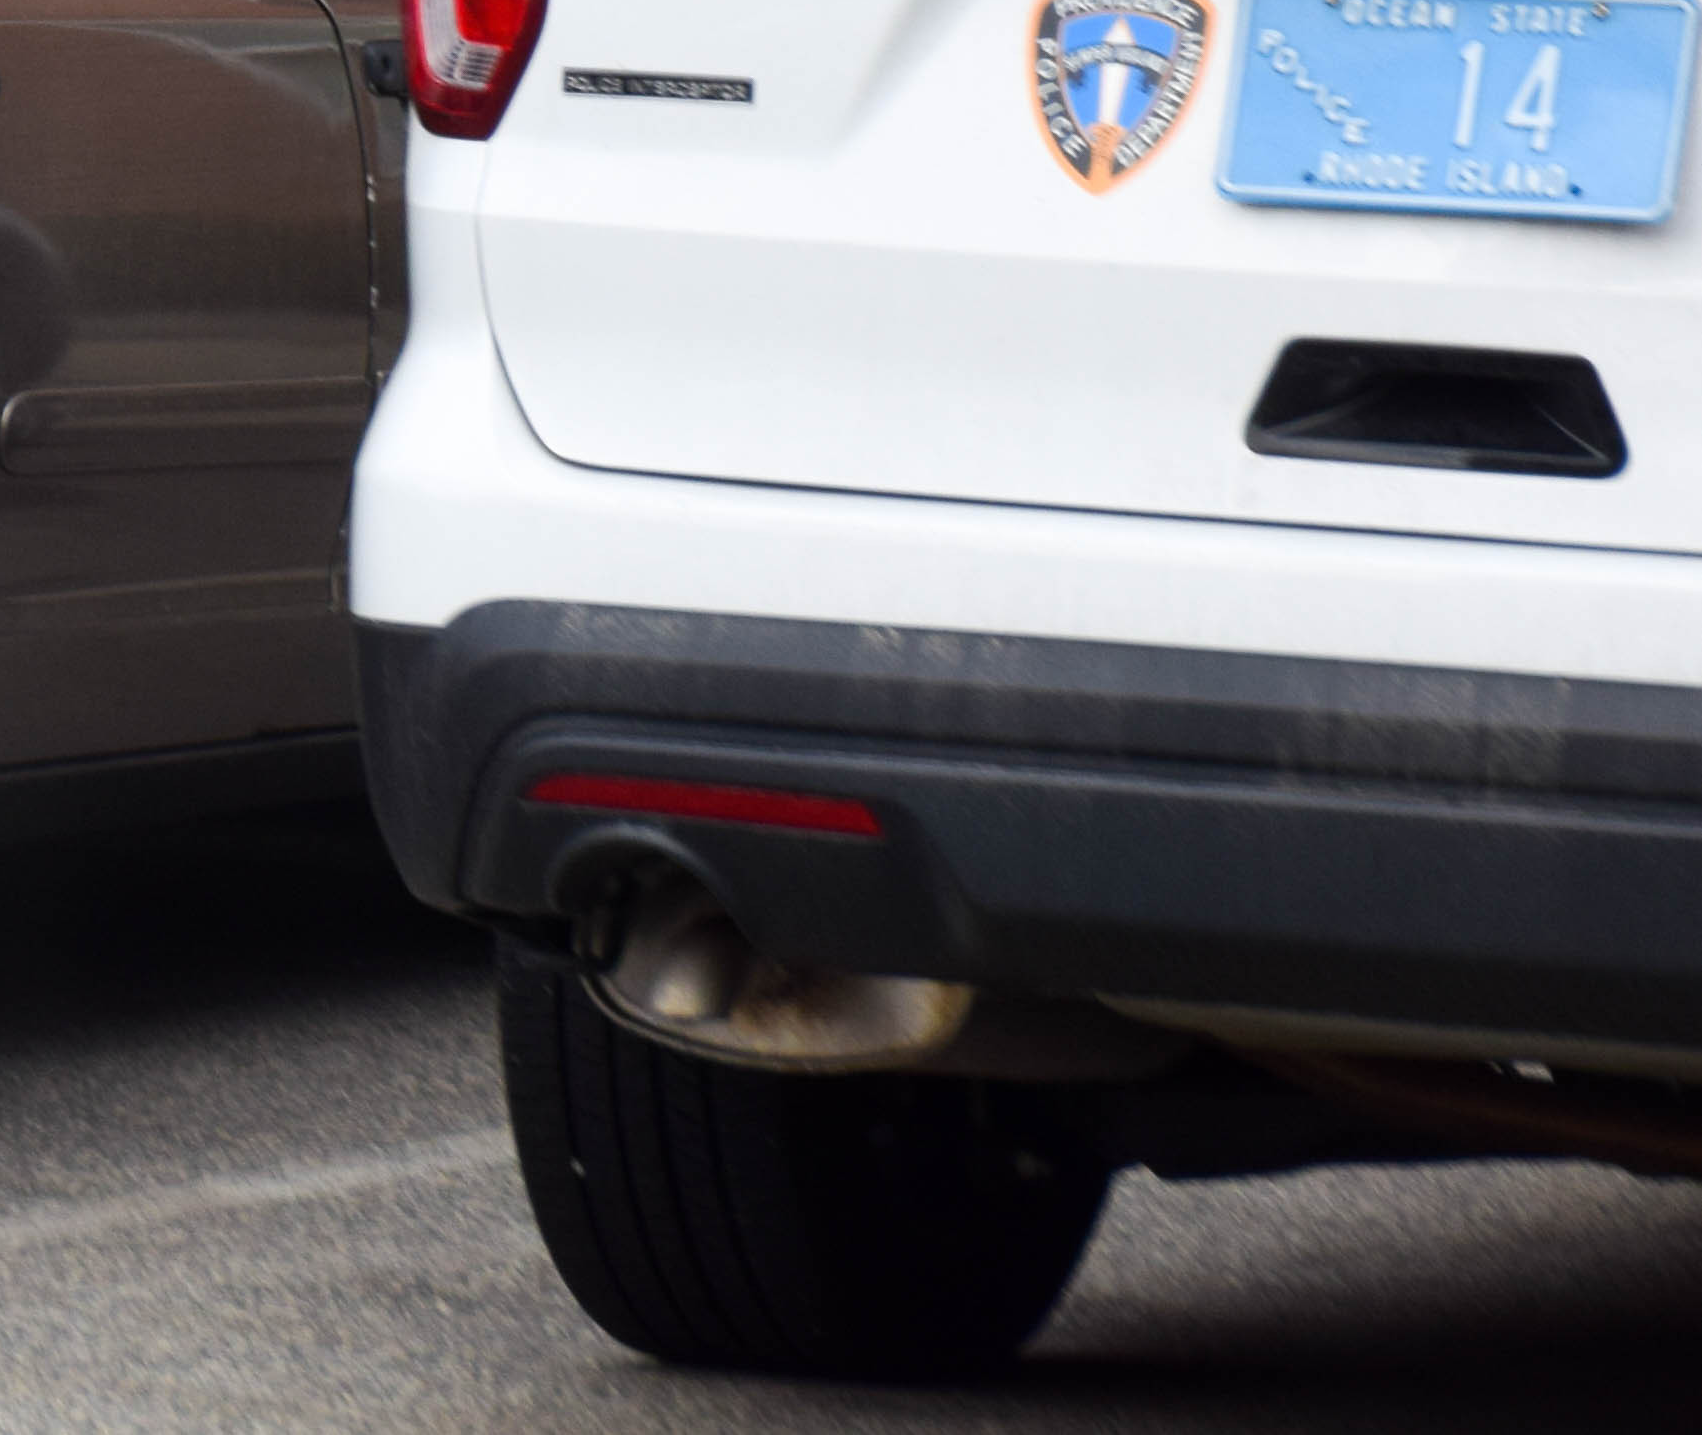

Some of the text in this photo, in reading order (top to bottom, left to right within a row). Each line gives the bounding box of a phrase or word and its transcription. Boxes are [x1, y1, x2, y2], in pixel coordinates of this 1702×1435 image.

[1489, 2, 1590, 38] STATE
[1036, 37, 1091, 160] POLICE
[1257, 28, 1371, 146] POLICE
[1452, 39, 1562, 153] 14
[1317, 151, 1572, 199] RHODE ISLAND
